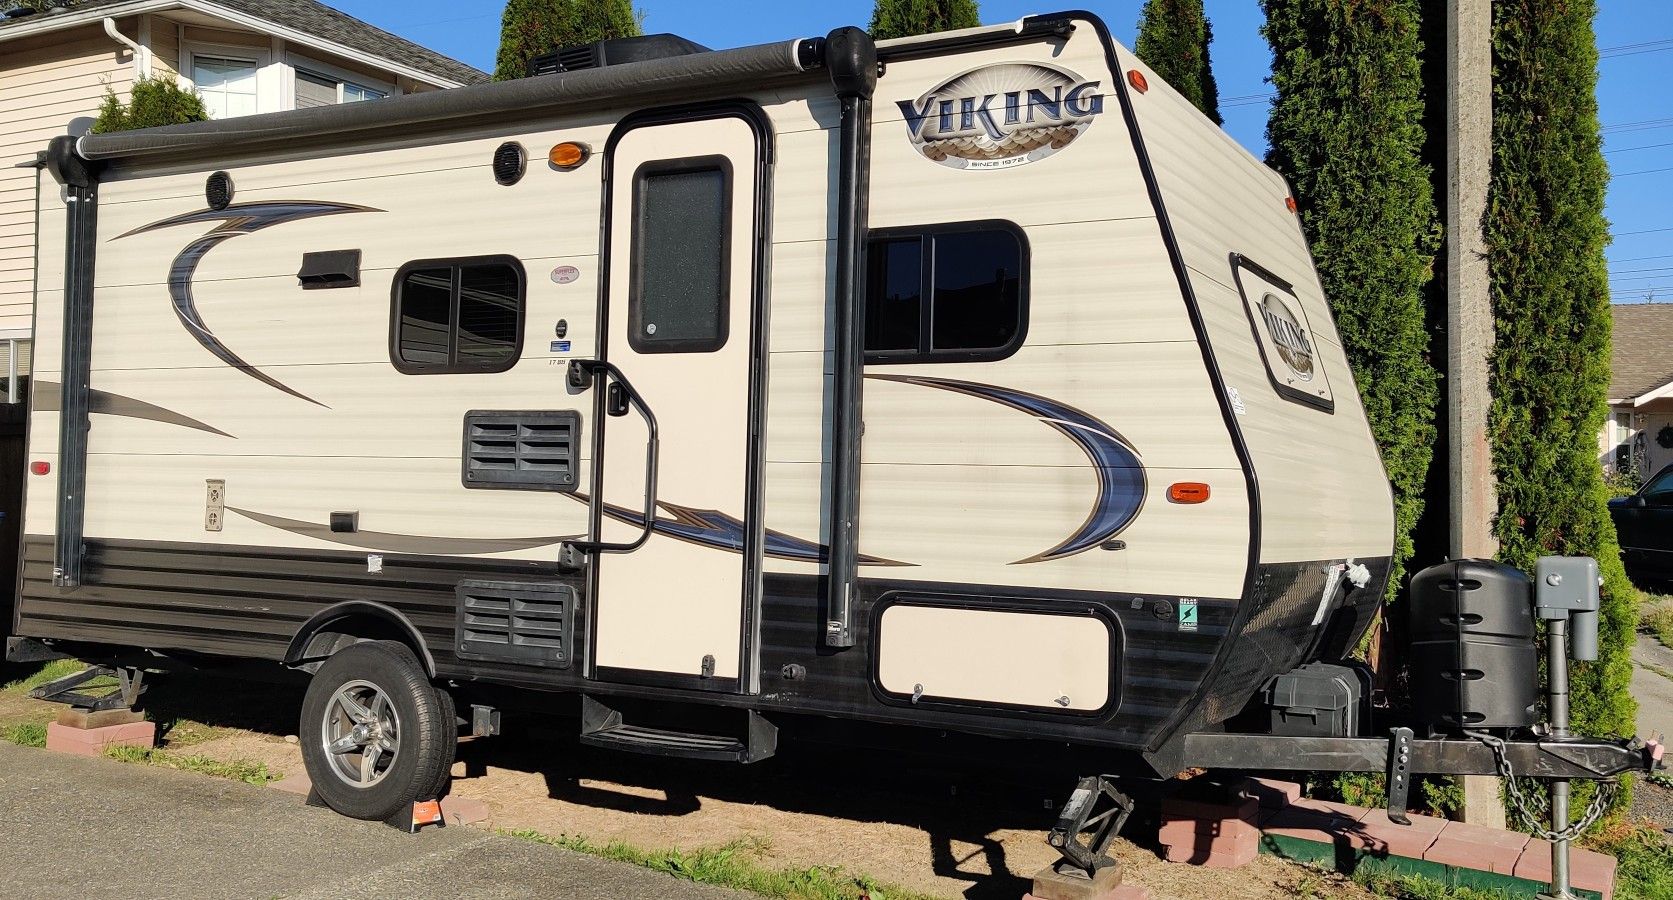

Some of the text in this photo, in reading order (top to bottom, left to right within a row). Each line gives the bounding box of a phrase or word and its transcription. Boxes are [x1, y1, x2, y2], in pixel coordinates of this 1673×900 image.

[895, 81, 1104, 141] VIKING
[1002, 157, 1024, 165] 1972
[1255, 301, 1313, 355] VIKING
